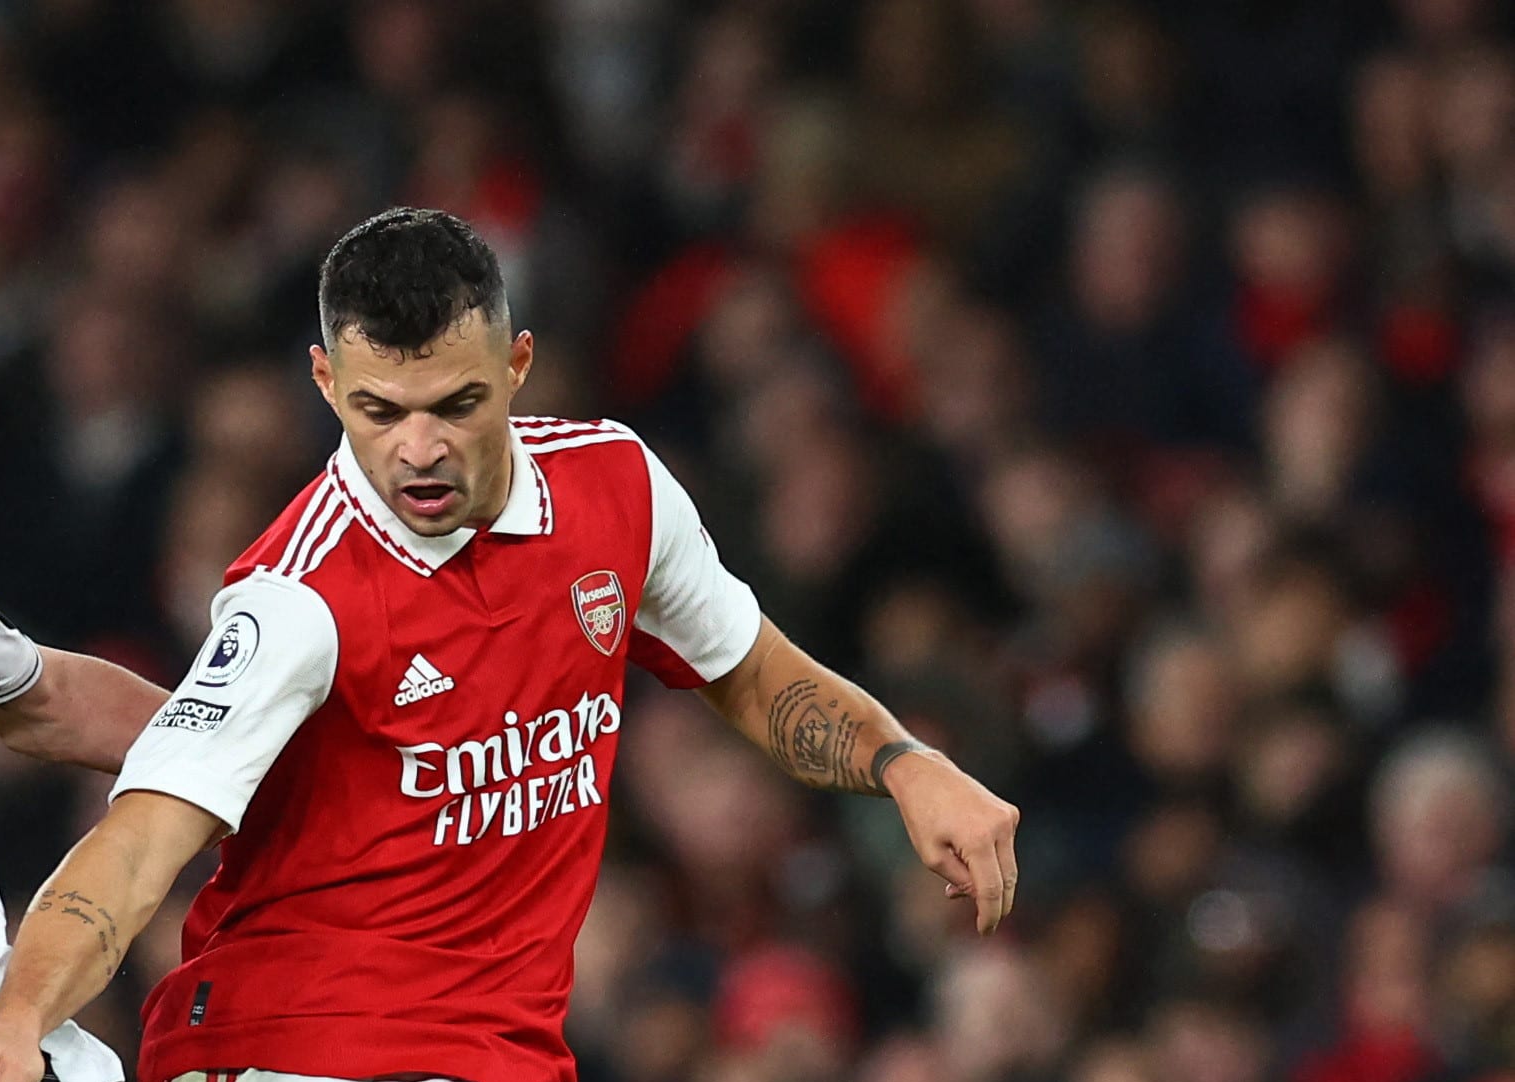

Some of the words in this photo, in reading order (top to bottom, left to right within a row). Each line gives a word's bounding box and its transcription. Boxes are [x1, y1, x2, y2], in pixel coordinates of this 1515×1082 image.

[579, 581, 616, 605] Arsenal
[394, 676, 455, 707] adidas
[180, 702, 223, 720] room
[394, 690, 622, 799] Emirates
